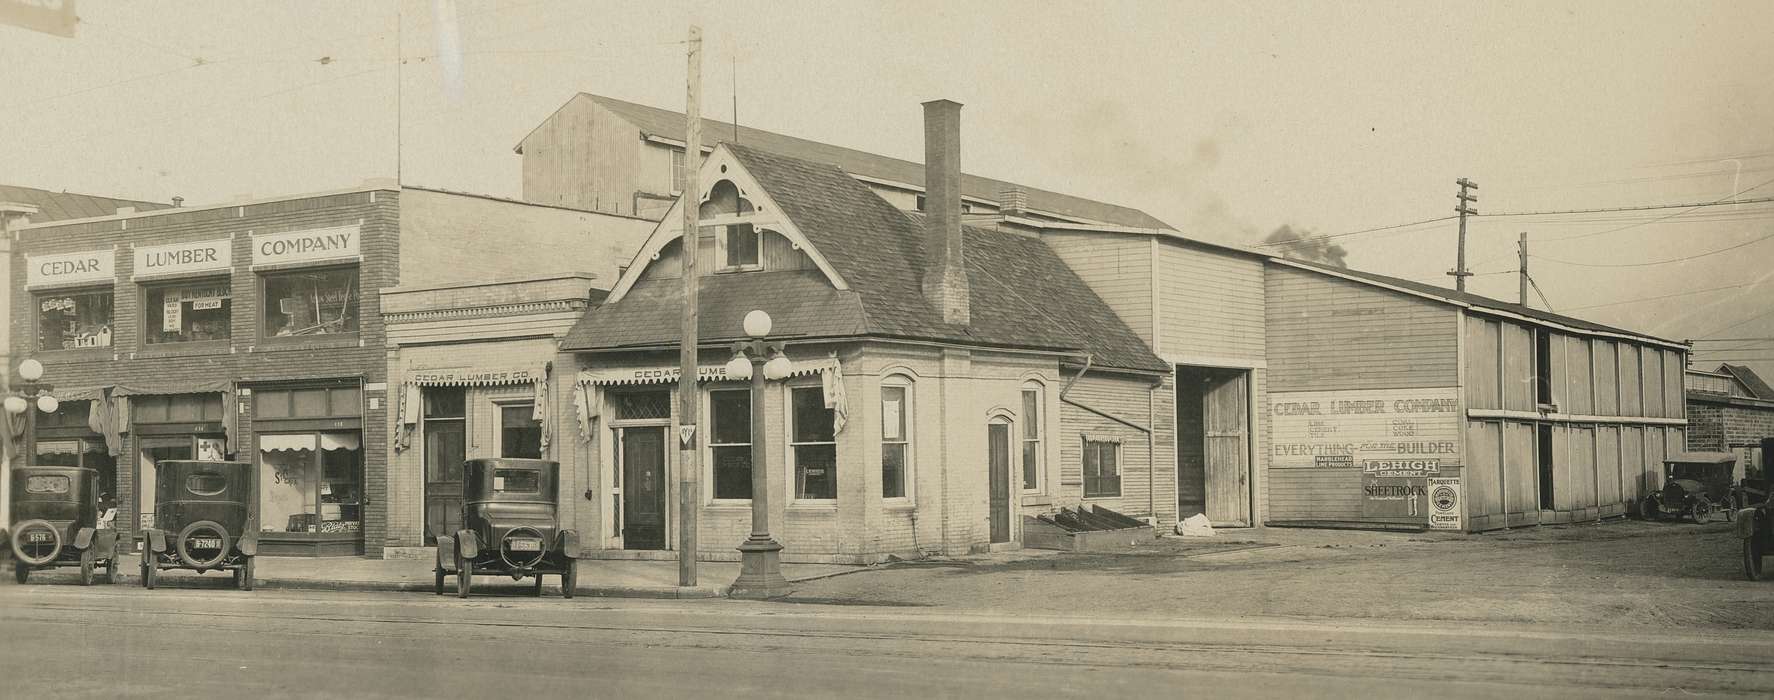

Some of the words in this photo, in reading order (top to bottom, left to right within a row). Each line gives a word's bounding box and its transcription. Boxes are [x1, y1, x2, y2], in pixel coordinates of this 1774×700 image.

[261, 233, 351, 256] COMPANY
[146, 248, 217, 267] LUMBER
[40, 258, 99, 276] CEDAR
[459, 372, 507, 381] LUMBER
[634, 369, 681, 379] CEDAR
[1273, 400, 1320, 416] CEDAR
[1330, 399, 1385, 414] LUMBER
[1394, 398, 1458, 413] COMPANY
[1397, 441, 1455, 454] BUILDER
[1365, 461, 1438, 472] LEHIGH
[1428, 478, 1459, 486] MARQUETTE
[1364, 485, 1426, 496] SHEETROCK
[1431, 514, 1459, 523] CEMENT
